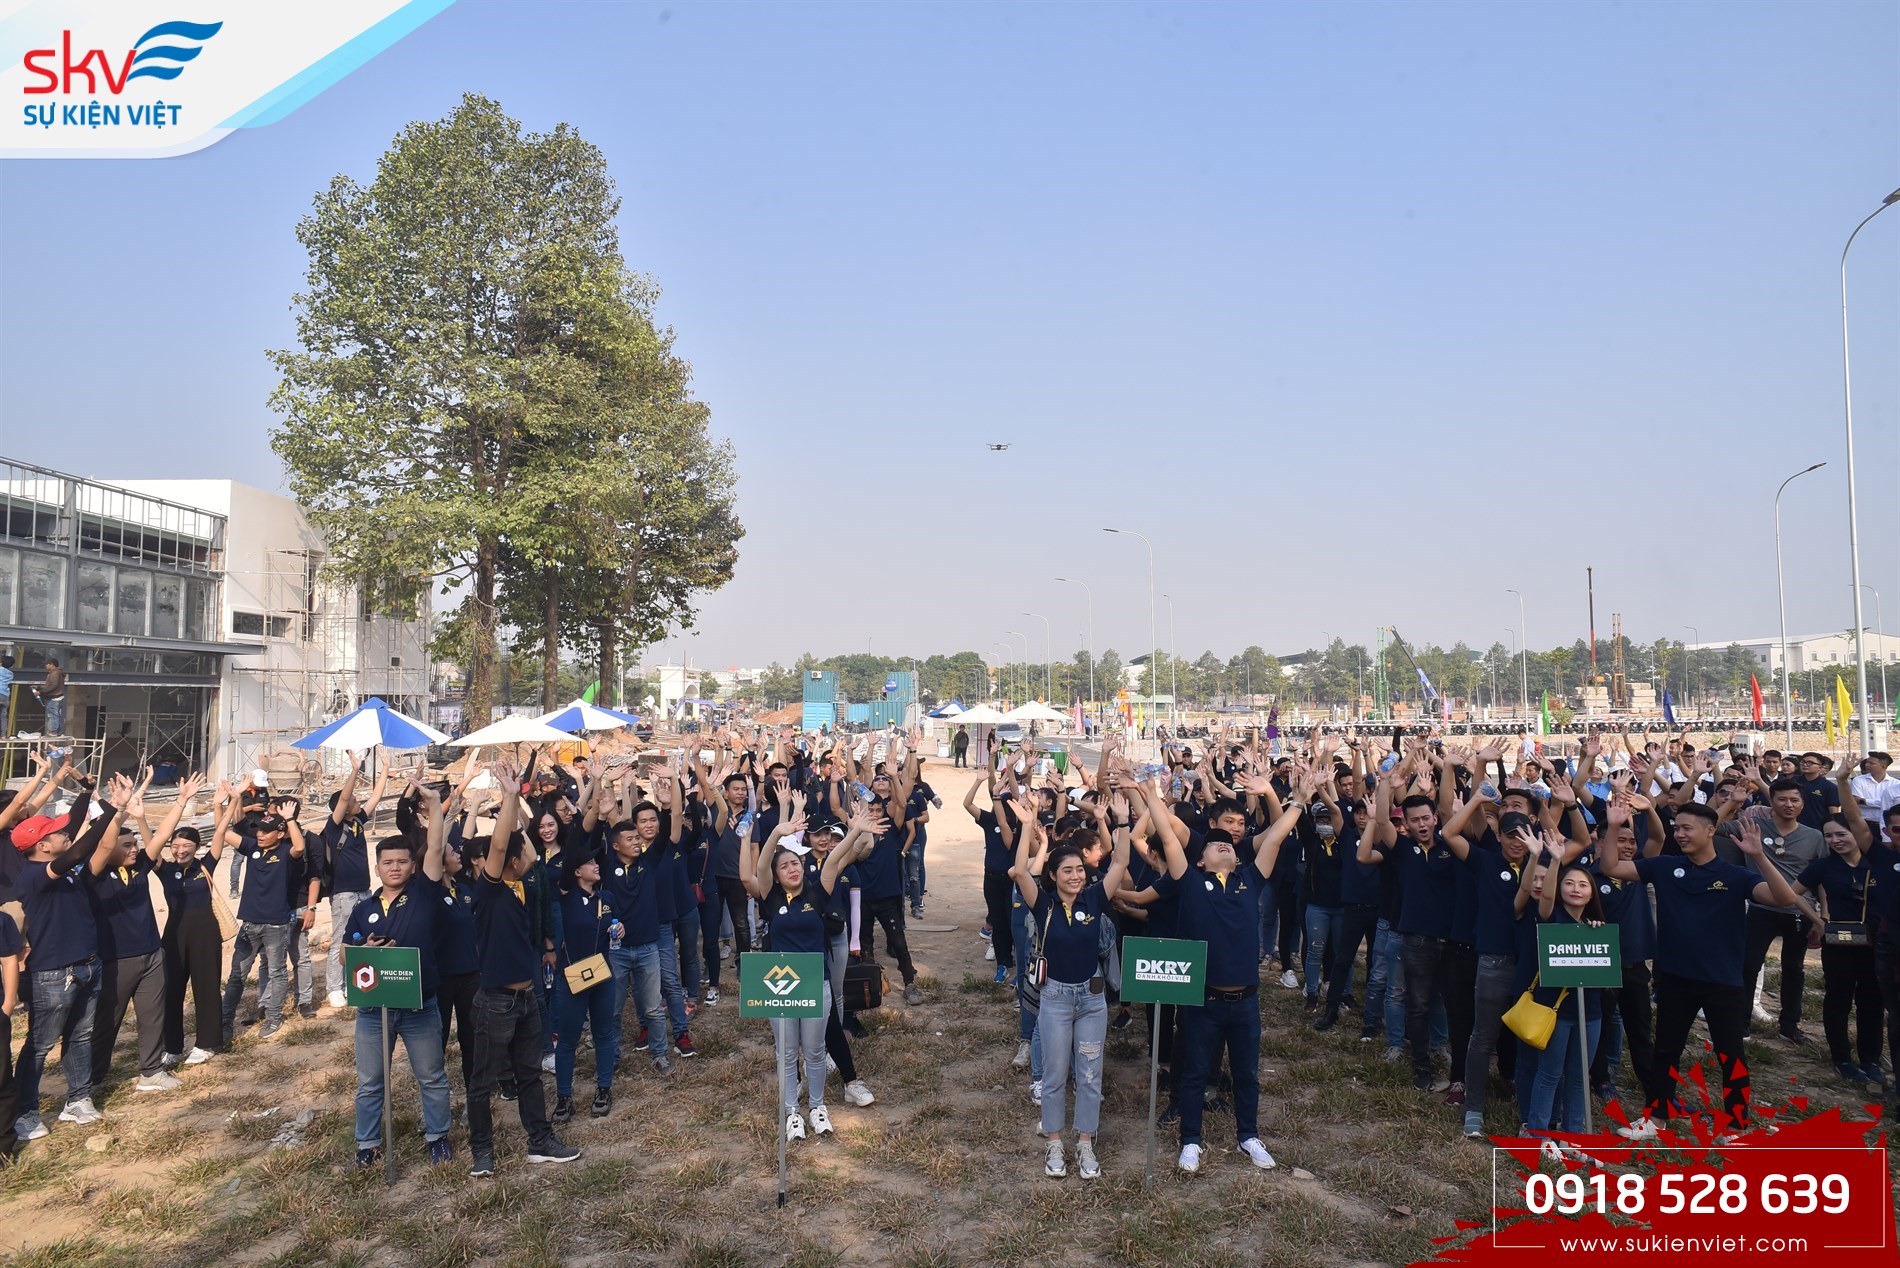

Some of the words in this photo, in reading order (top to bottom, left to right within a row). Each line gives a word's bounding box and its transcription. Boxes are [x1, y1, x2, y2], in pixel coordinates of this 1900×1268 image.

[1548, 943, 1581, 955] DANH
[1583, 943, 1610, 954] VIET
[1135, 959, 1192, 974] DKRV
[747, 999, 763, 1007] GM
[764, 999, 817, 1007] HOLDINGS
